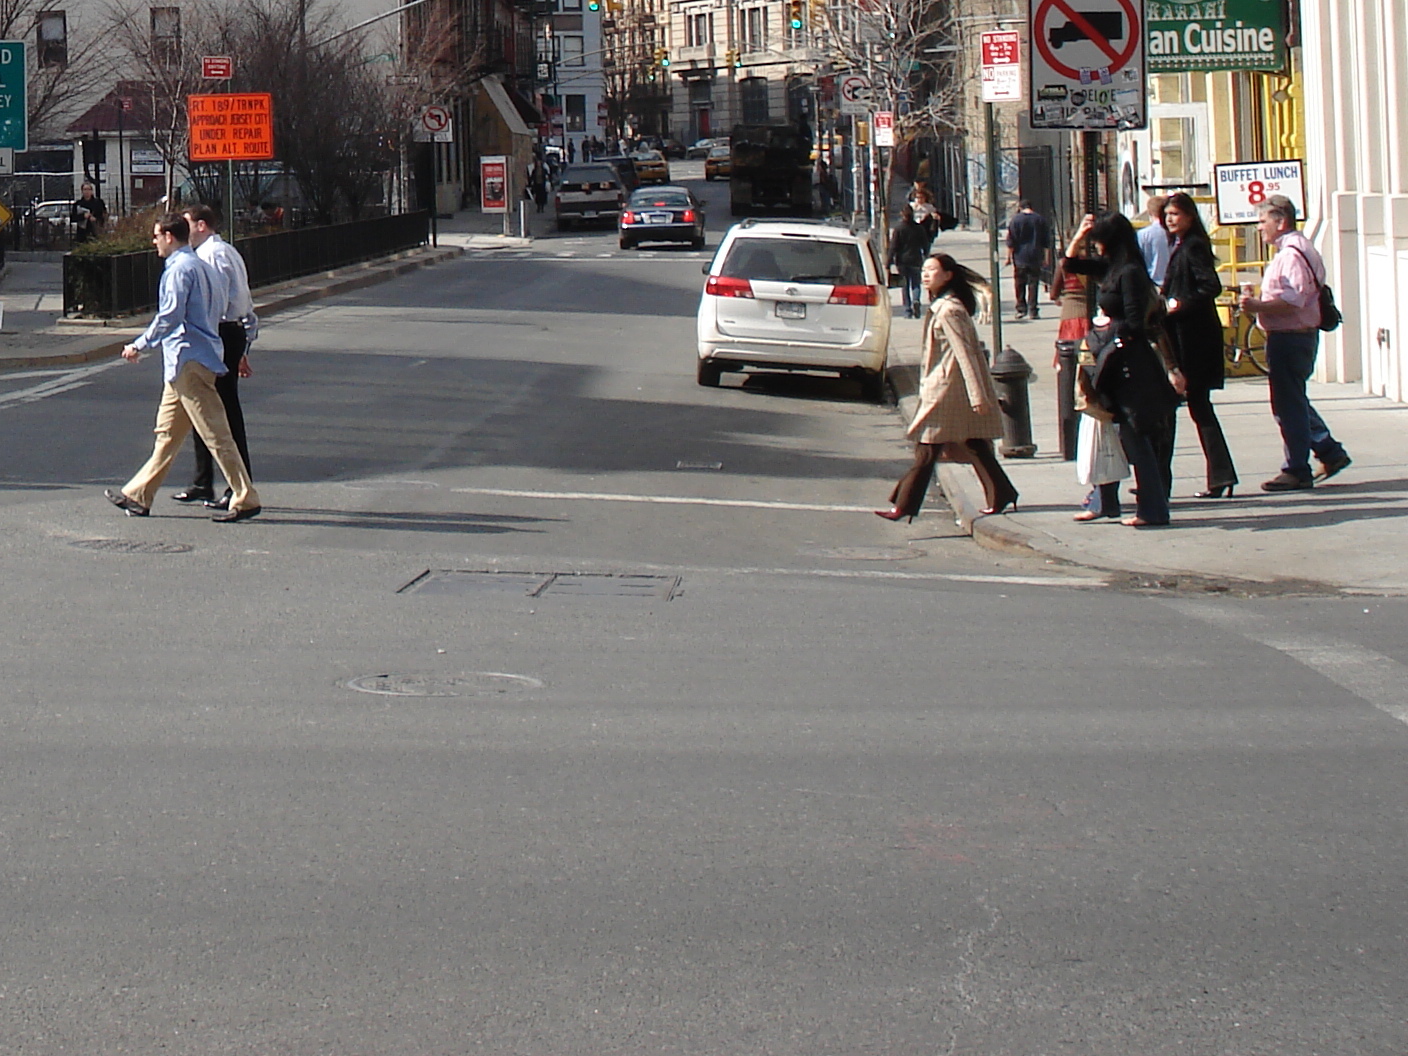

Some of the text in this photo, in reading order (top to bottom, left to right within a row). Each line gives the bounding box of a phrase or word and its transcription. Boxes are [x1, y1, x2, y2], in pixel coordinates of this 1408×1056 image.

[1184, 20, 1275, 55] Cuisine
[192, 99, 208, 112] RT.
[230, 113, 252, 125] JERSEY
[254, 113, 268, 125] CITY
[200, 127, 262, 141] UNDER REPAIR
[194, 141, 270, 155] PLAN ALT. ROUTE
[1220, 166, 1299, 183] BUFFET LUNCH
